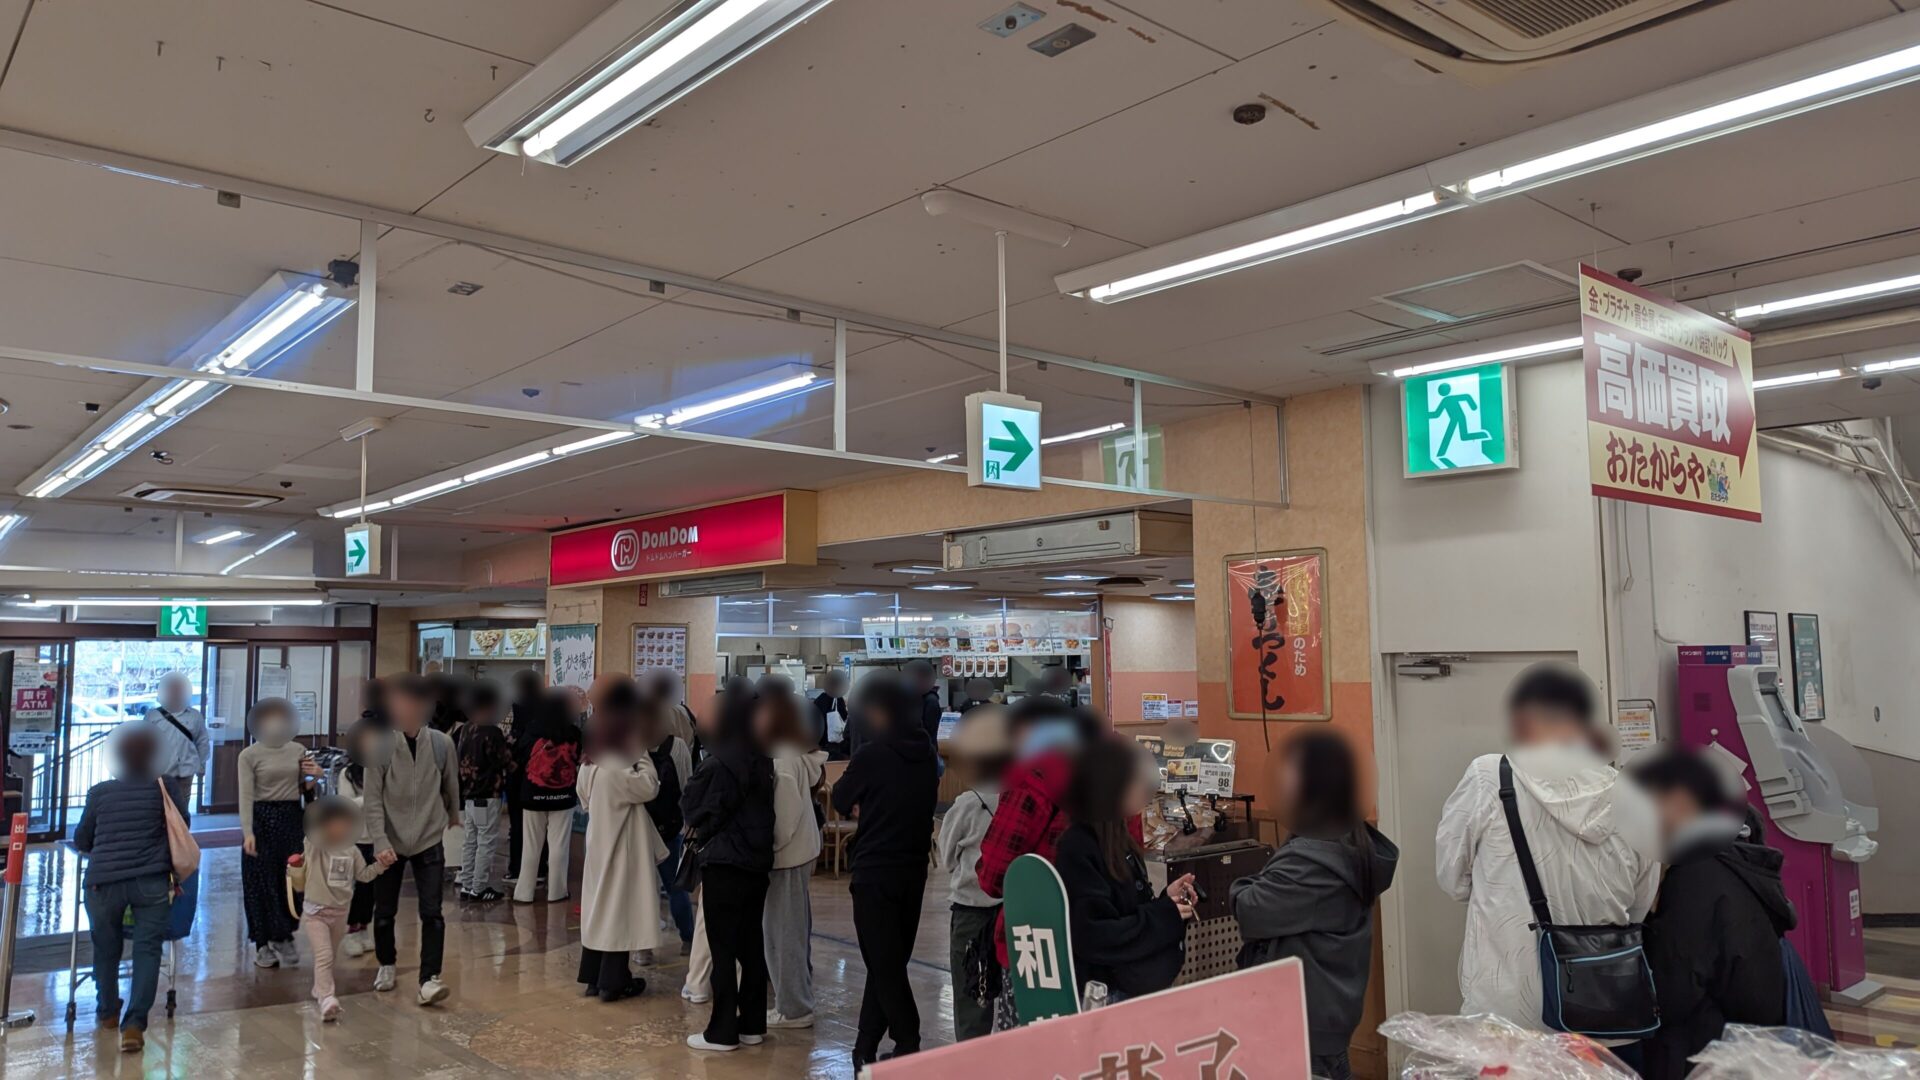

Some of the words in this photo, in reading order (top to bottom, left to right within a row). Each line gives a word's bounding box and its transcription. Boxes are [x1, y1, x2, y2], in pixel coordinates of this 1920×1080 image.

[1593, 330, 1731, 445] 高価買取
[1606, 430, 1706, 499] おたからや
[1293, 637, 1307, 676] のため
[22, 690, 47, 700] 銀行
[22, 700, 48, 709] ATM
[1218, 778, 1229, 787] 98
[13, 824, 24, 851] 出口
[1012, 924, 1062, 1028] 和
